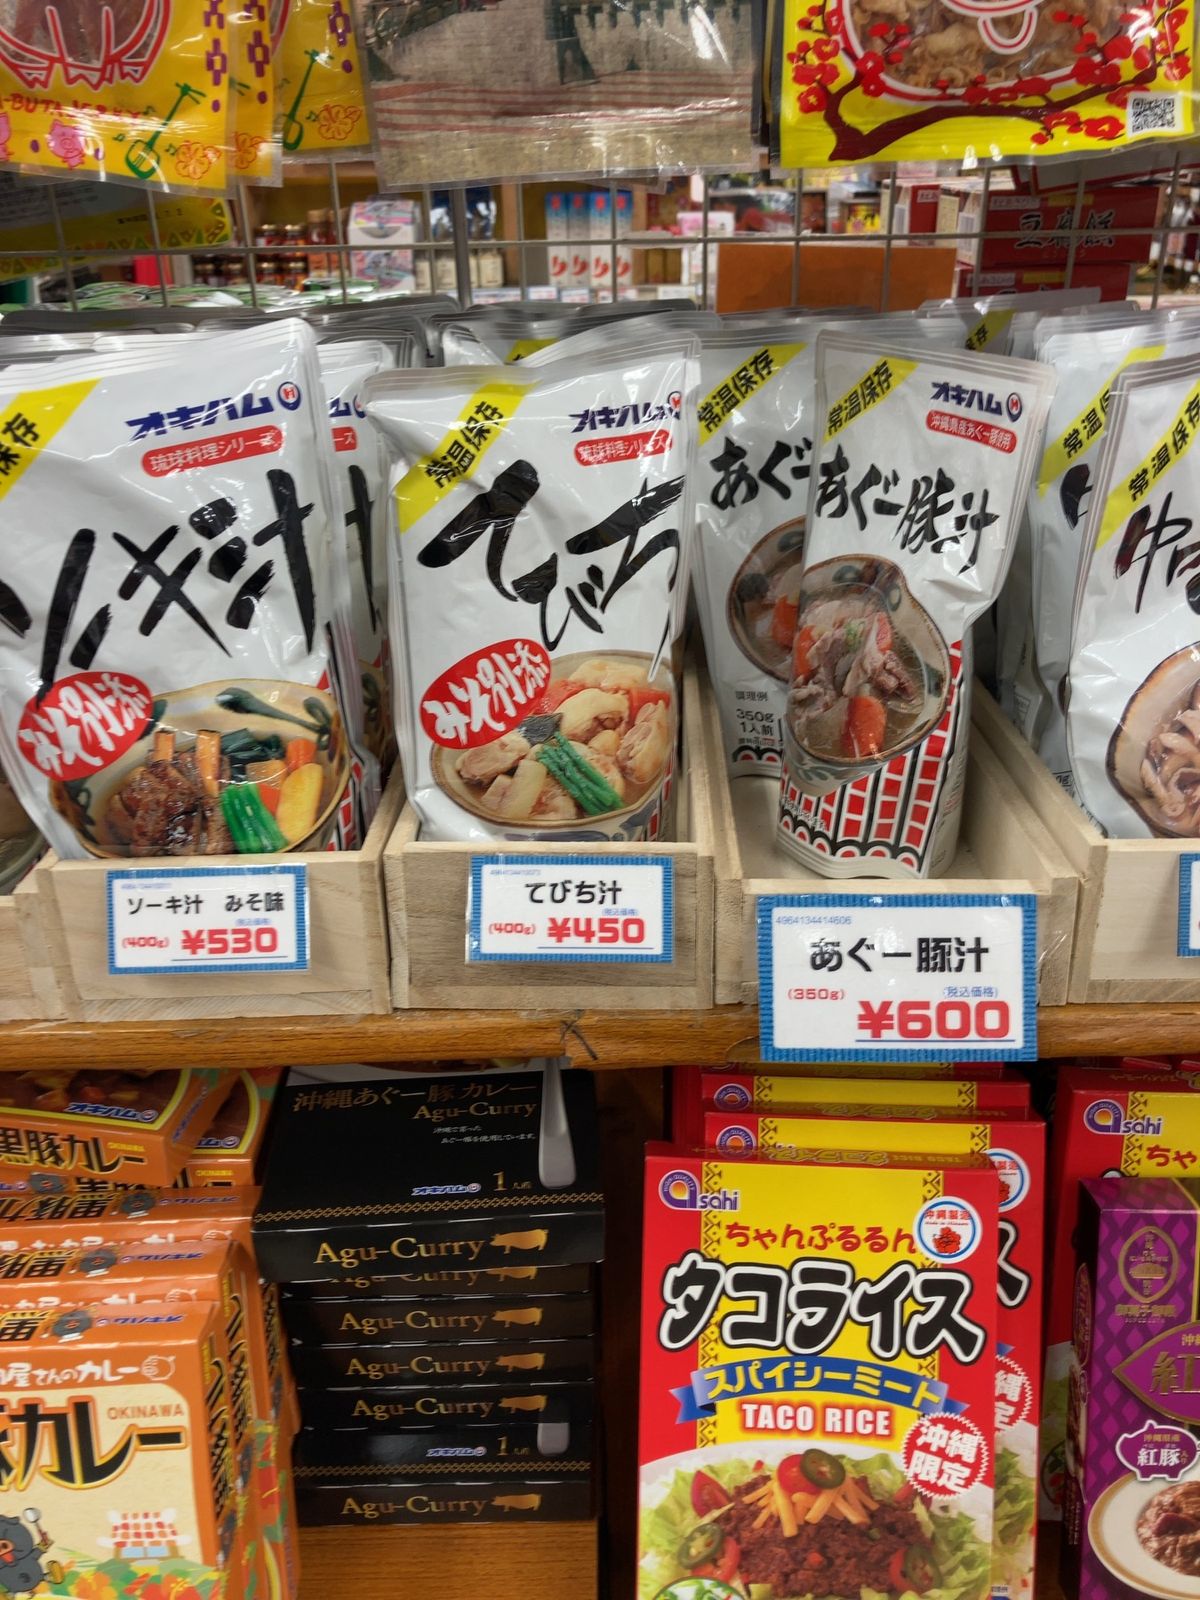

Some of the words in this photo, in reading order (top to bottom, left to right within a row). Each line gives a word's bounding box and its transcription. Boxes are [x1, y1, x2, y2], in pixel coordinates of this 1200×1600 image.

[0, 93, 63, 117] -BUTA
[697, 348, 776, 433] 常温保存
[827, 361, 894, 436] 常温保存
[931, 382, 1002, 416] オキハム
[125, 392, 275, 442] オキハム
[425, 400, 505, 490] 常温保存
[1127, 392, 1200, 503] 常温保存
[736, 708, 774, 723] 350g
[128, 894, 204, 914] ソーキ汁
[224, 891, 285, 913] みそ味
[525, 880, 622, 905] てびち汁
[181, 927, 279, 955] ¥530
[488, 922, 537, 935] (400g)
[547, 917, 646, 943] ¥450
[809, 936, 990, 973] あぐー豚汁
[787, 988, 845, 1000] (350g)
[857, 1000, 1011, 1039] ¥600
[65, 1102, 141, 1121] オキハム
[412, 1102, 537, 1122] Agu-Curry
[726, 1221, 915, 1253] ちゃんぷるるん
[313, 1237, 485, 1269] Agu-Curry
[657, 1250, 988, 1366] タコライス
[339, 1310, 488, 1335] Agu-Curry
[0, 1360, 140, 1387] 屋さんのカレー
[346, 1356, 491, 1379] Agu-Curry
[704, 1360, 942, 1409] スパイシーミート
[107, 1404, 185, 1421] OKINAWA
[352, 1398, 495, 1420] Agu-Curry
[742, 1403, 814, 1432] TACO
[825, 1408, 891, 1435] RICE
[914, 1421, 978, 1464] 沖縄
[908, 1451, 969, 1492] 限定
[1137, 1448, 1181, 1467] 紅豚
[341, 1496, 487, 1518] Agu-Curry
